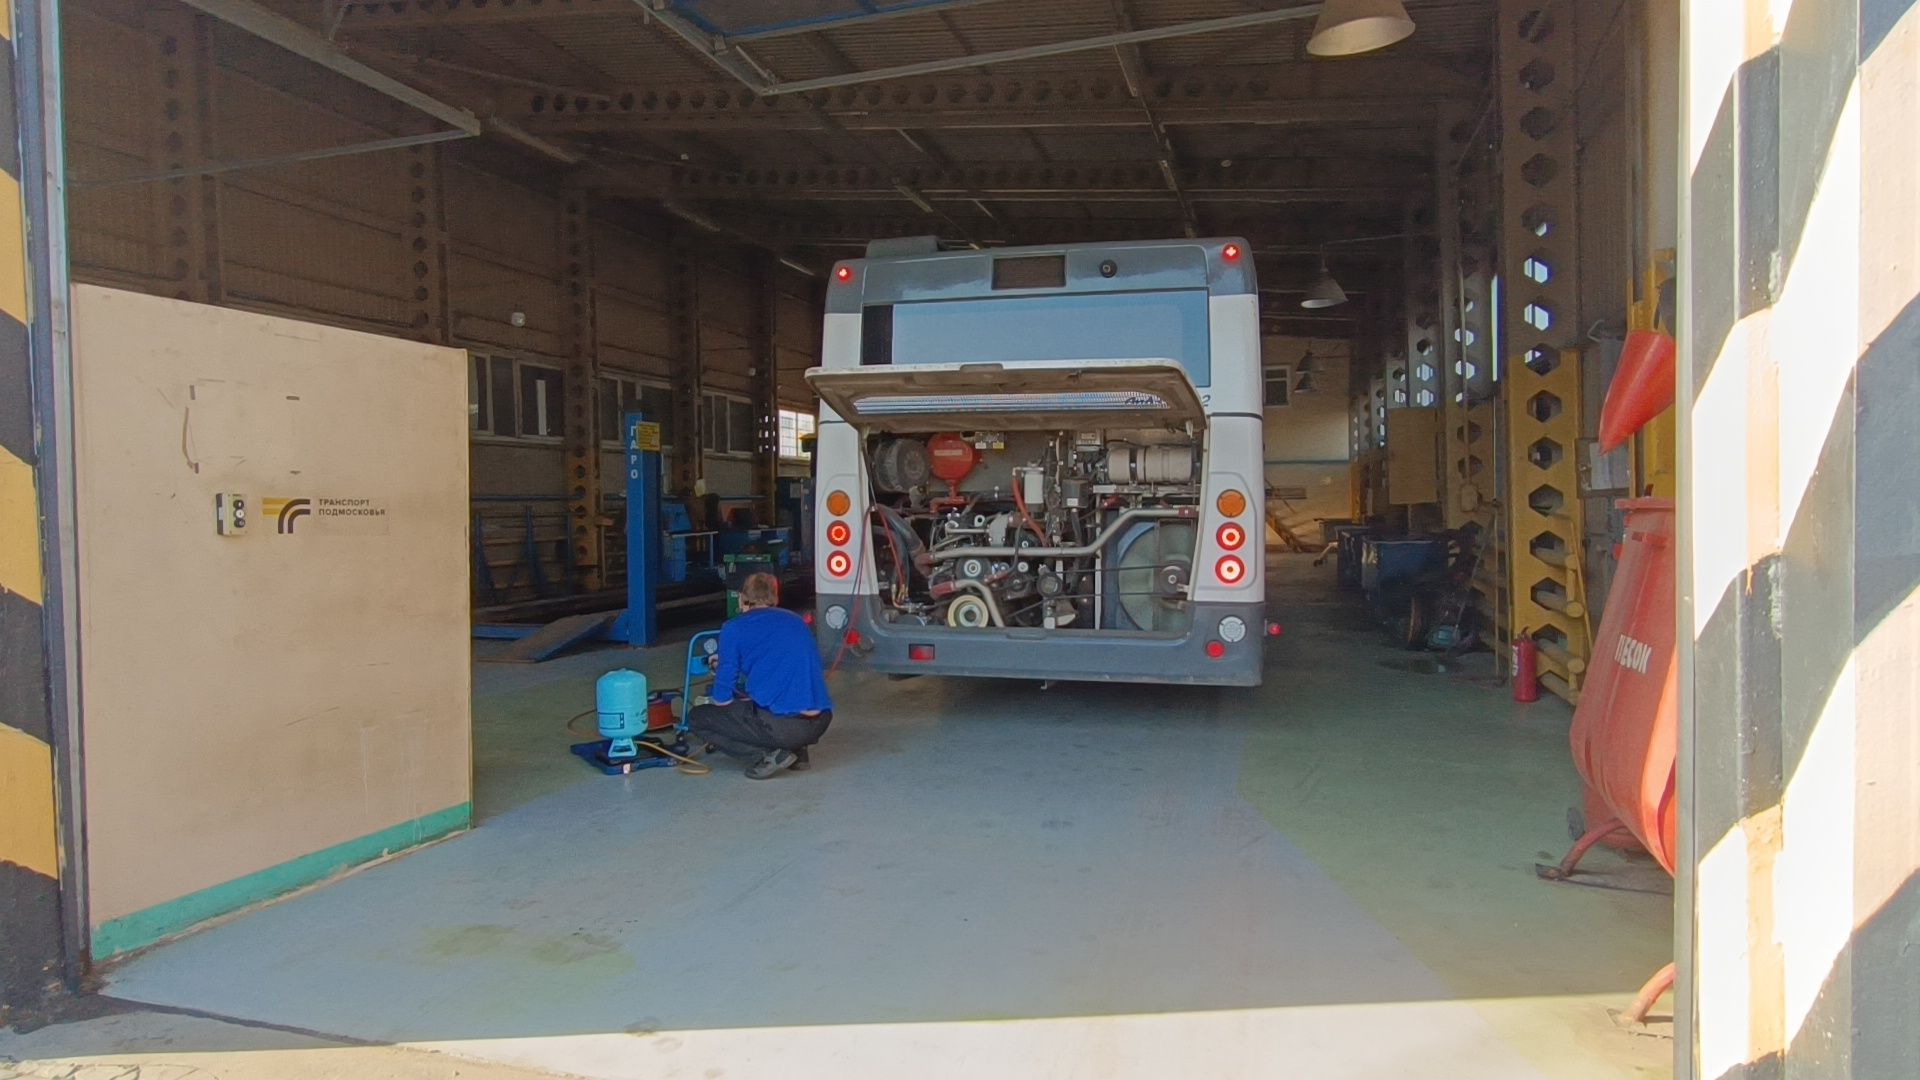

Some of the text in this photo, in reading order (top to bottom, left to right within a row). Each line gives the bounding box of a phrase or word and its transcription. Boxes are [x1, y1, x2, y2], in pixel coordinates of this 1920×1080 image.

[630, 425, 639, 479] ГАРО
[318, 498, 370, 506] ТРАНСПОРТ
[318, 508, 386, 517] ПОДМОСКОВЬЯ
[1614, 634, 1652, 674] ПЕСОК
